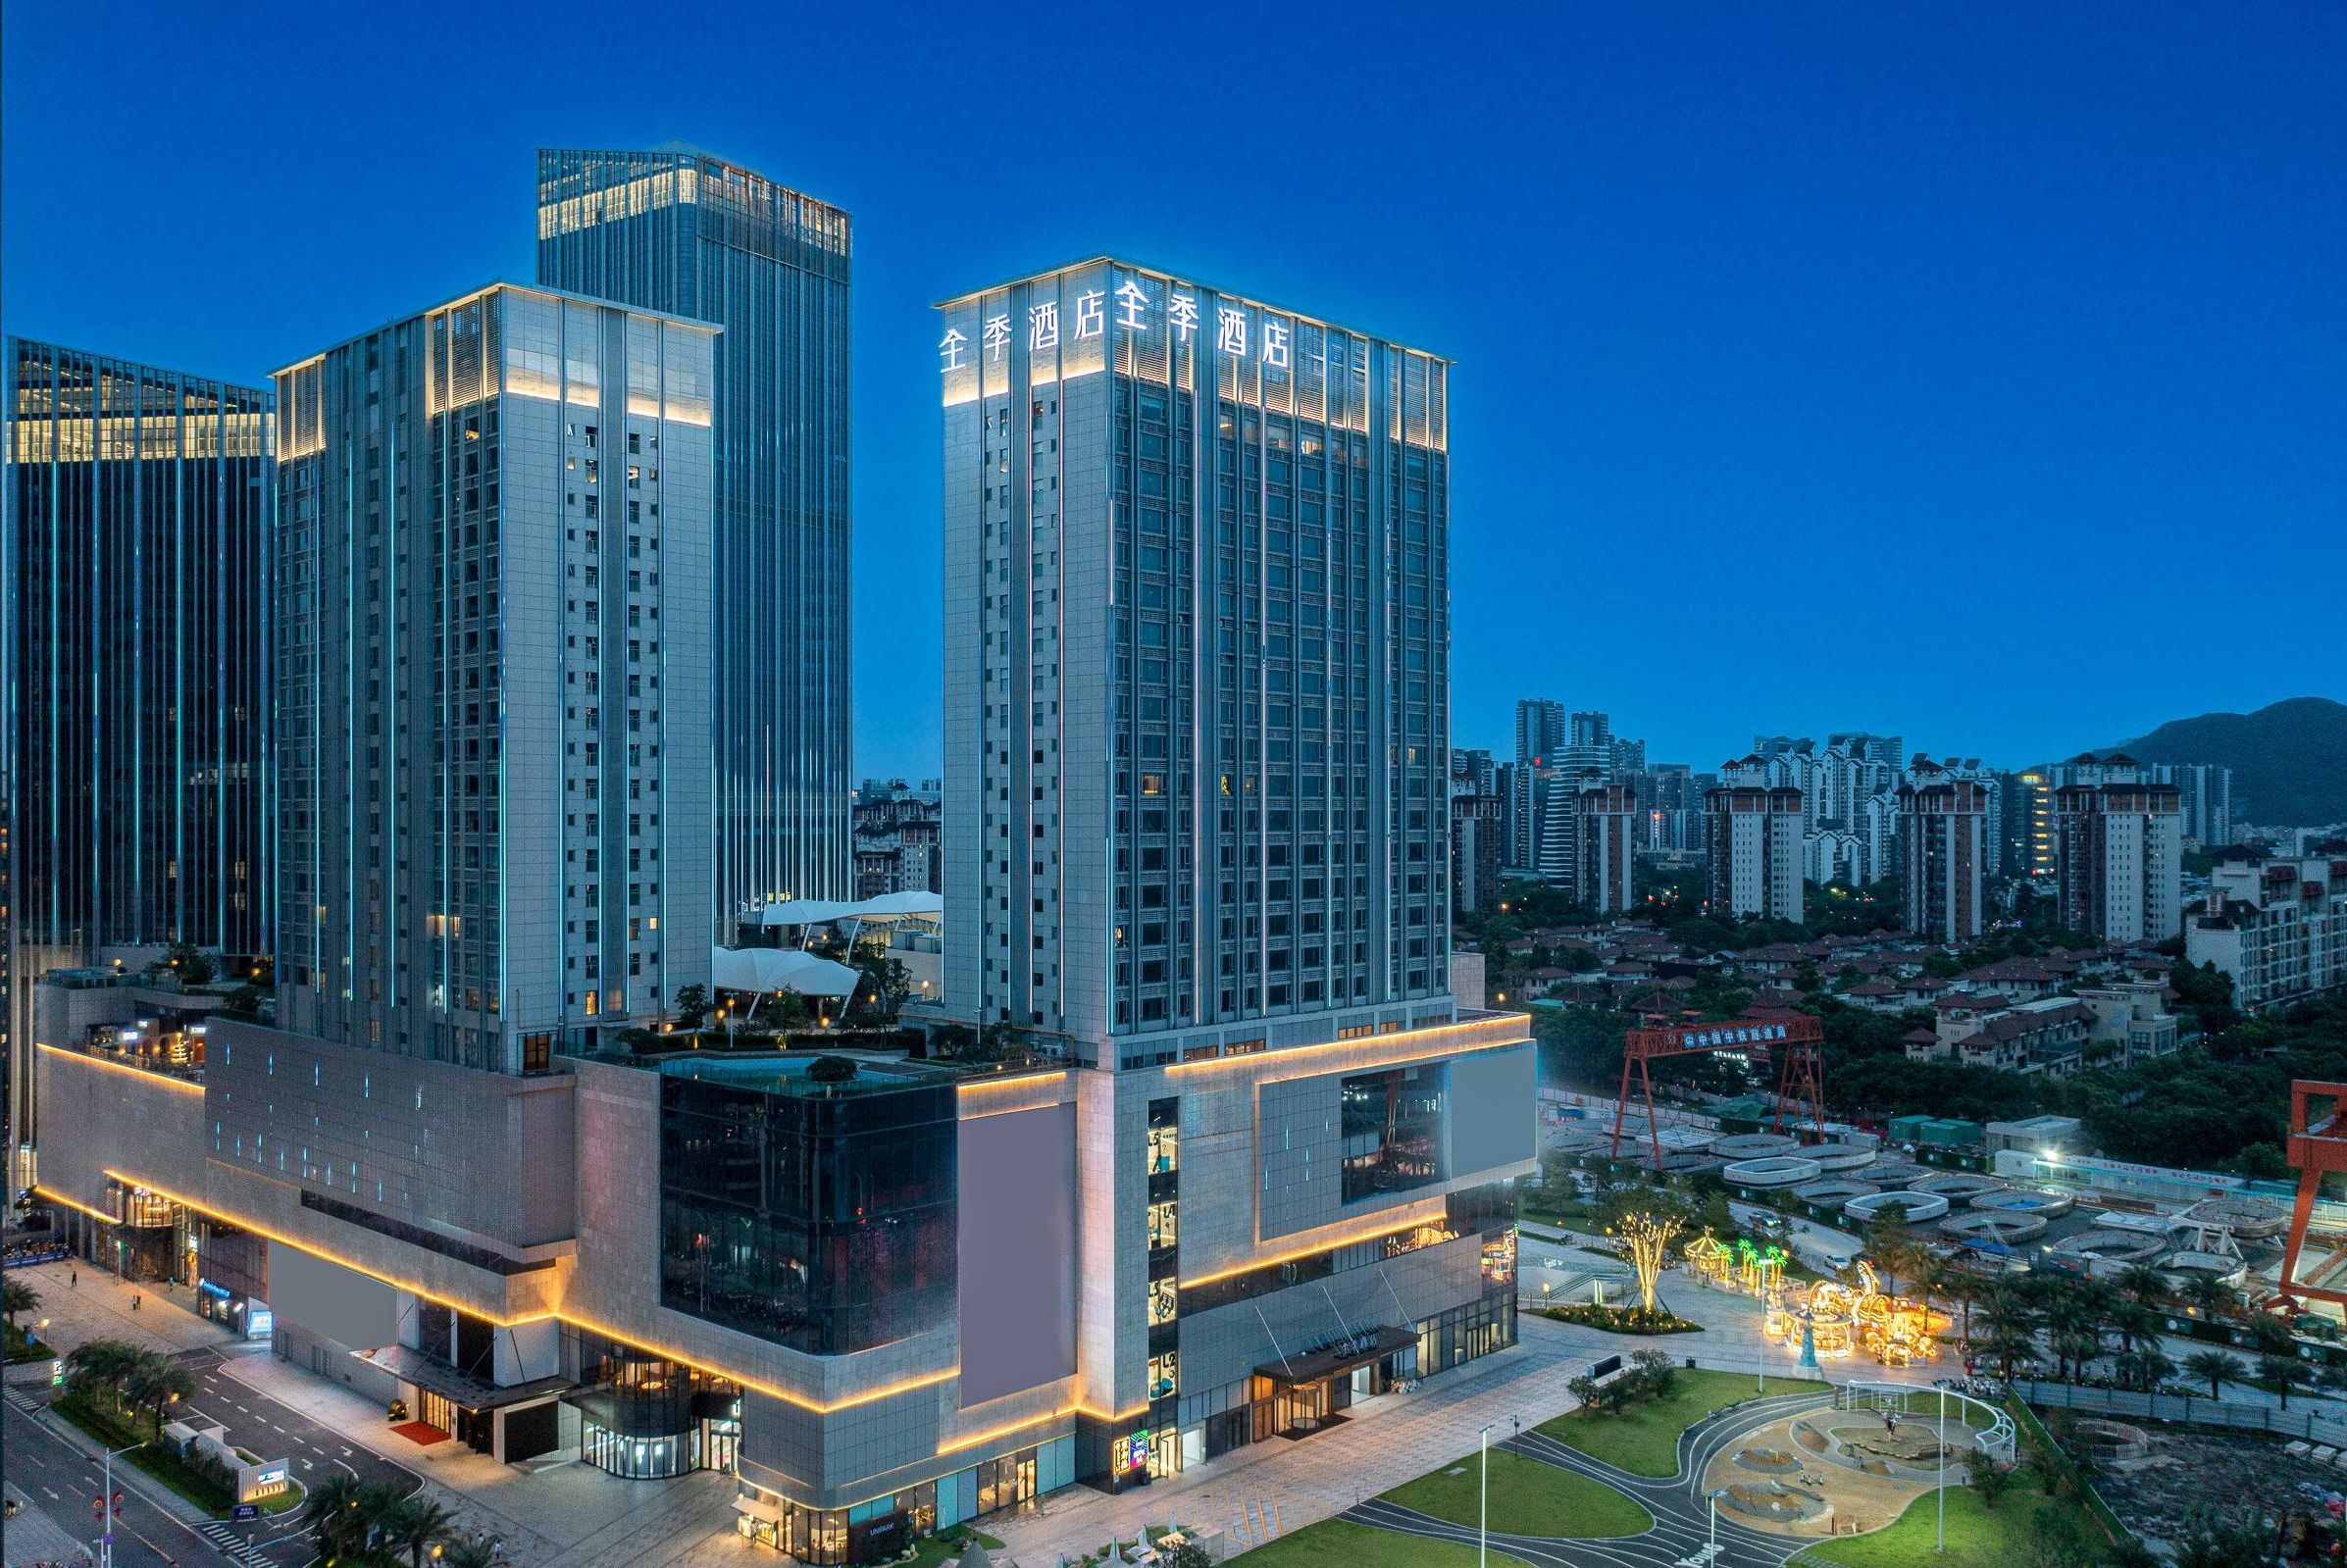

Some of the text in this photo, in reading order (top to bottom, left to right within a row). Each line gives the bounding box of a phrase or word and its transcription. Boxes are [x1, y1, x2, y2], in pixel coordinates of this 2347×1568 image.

[939, 289, 1106, 374] 全季酒店
[1114, 280, 1290, 369] 全季酒店
[1162, 1352, 1176, 1368] L2
[869, 1523, 894, 1537] UNIPARK
